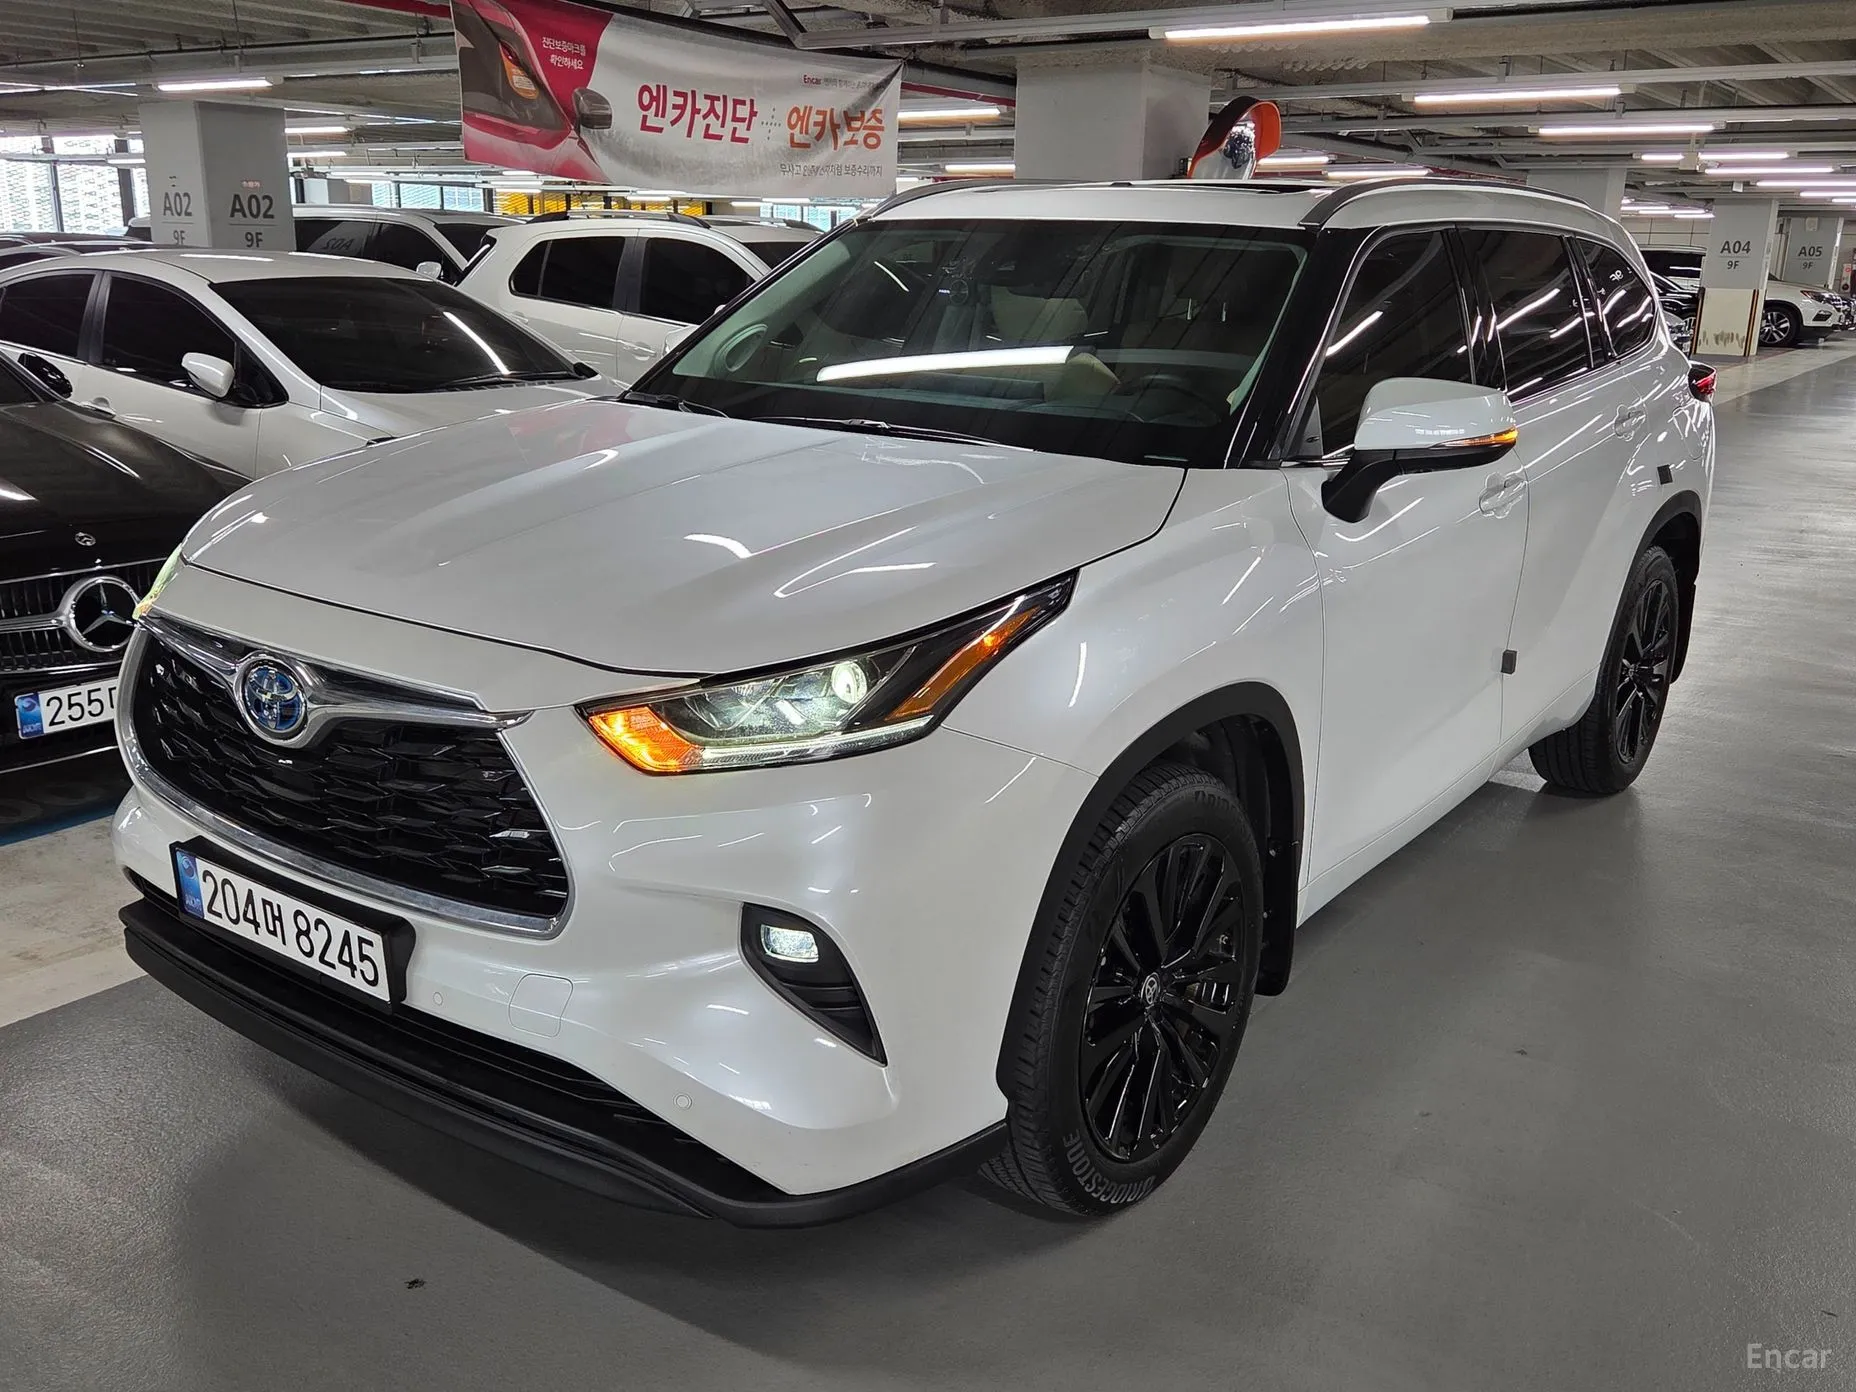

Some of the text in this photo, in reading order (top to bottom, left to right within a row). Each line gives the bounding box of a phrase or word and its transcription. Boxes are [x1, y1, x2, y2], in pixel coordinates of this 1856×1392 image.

[803, 74, 821, 85] Encar
[637, 84, 758, 144] 엔카진단
[780, 163, 801, 176] 무사고
[844, 164, 883, 177] 보증수리까지
[163, 192, 192, 216] A02
[229, 194, 275, 219] A02
[173, 230, 186, 245] 9F
[245, 232, 263, 247] 9F
[1720, 240, 1752, 254] A04
[1798, 246, 1822, 257] A05
[1727, 260, 1739, 270] 9F
[1802, 262, 1813, 270] 9F
[202, 869, 379, 988] 204머 8245
